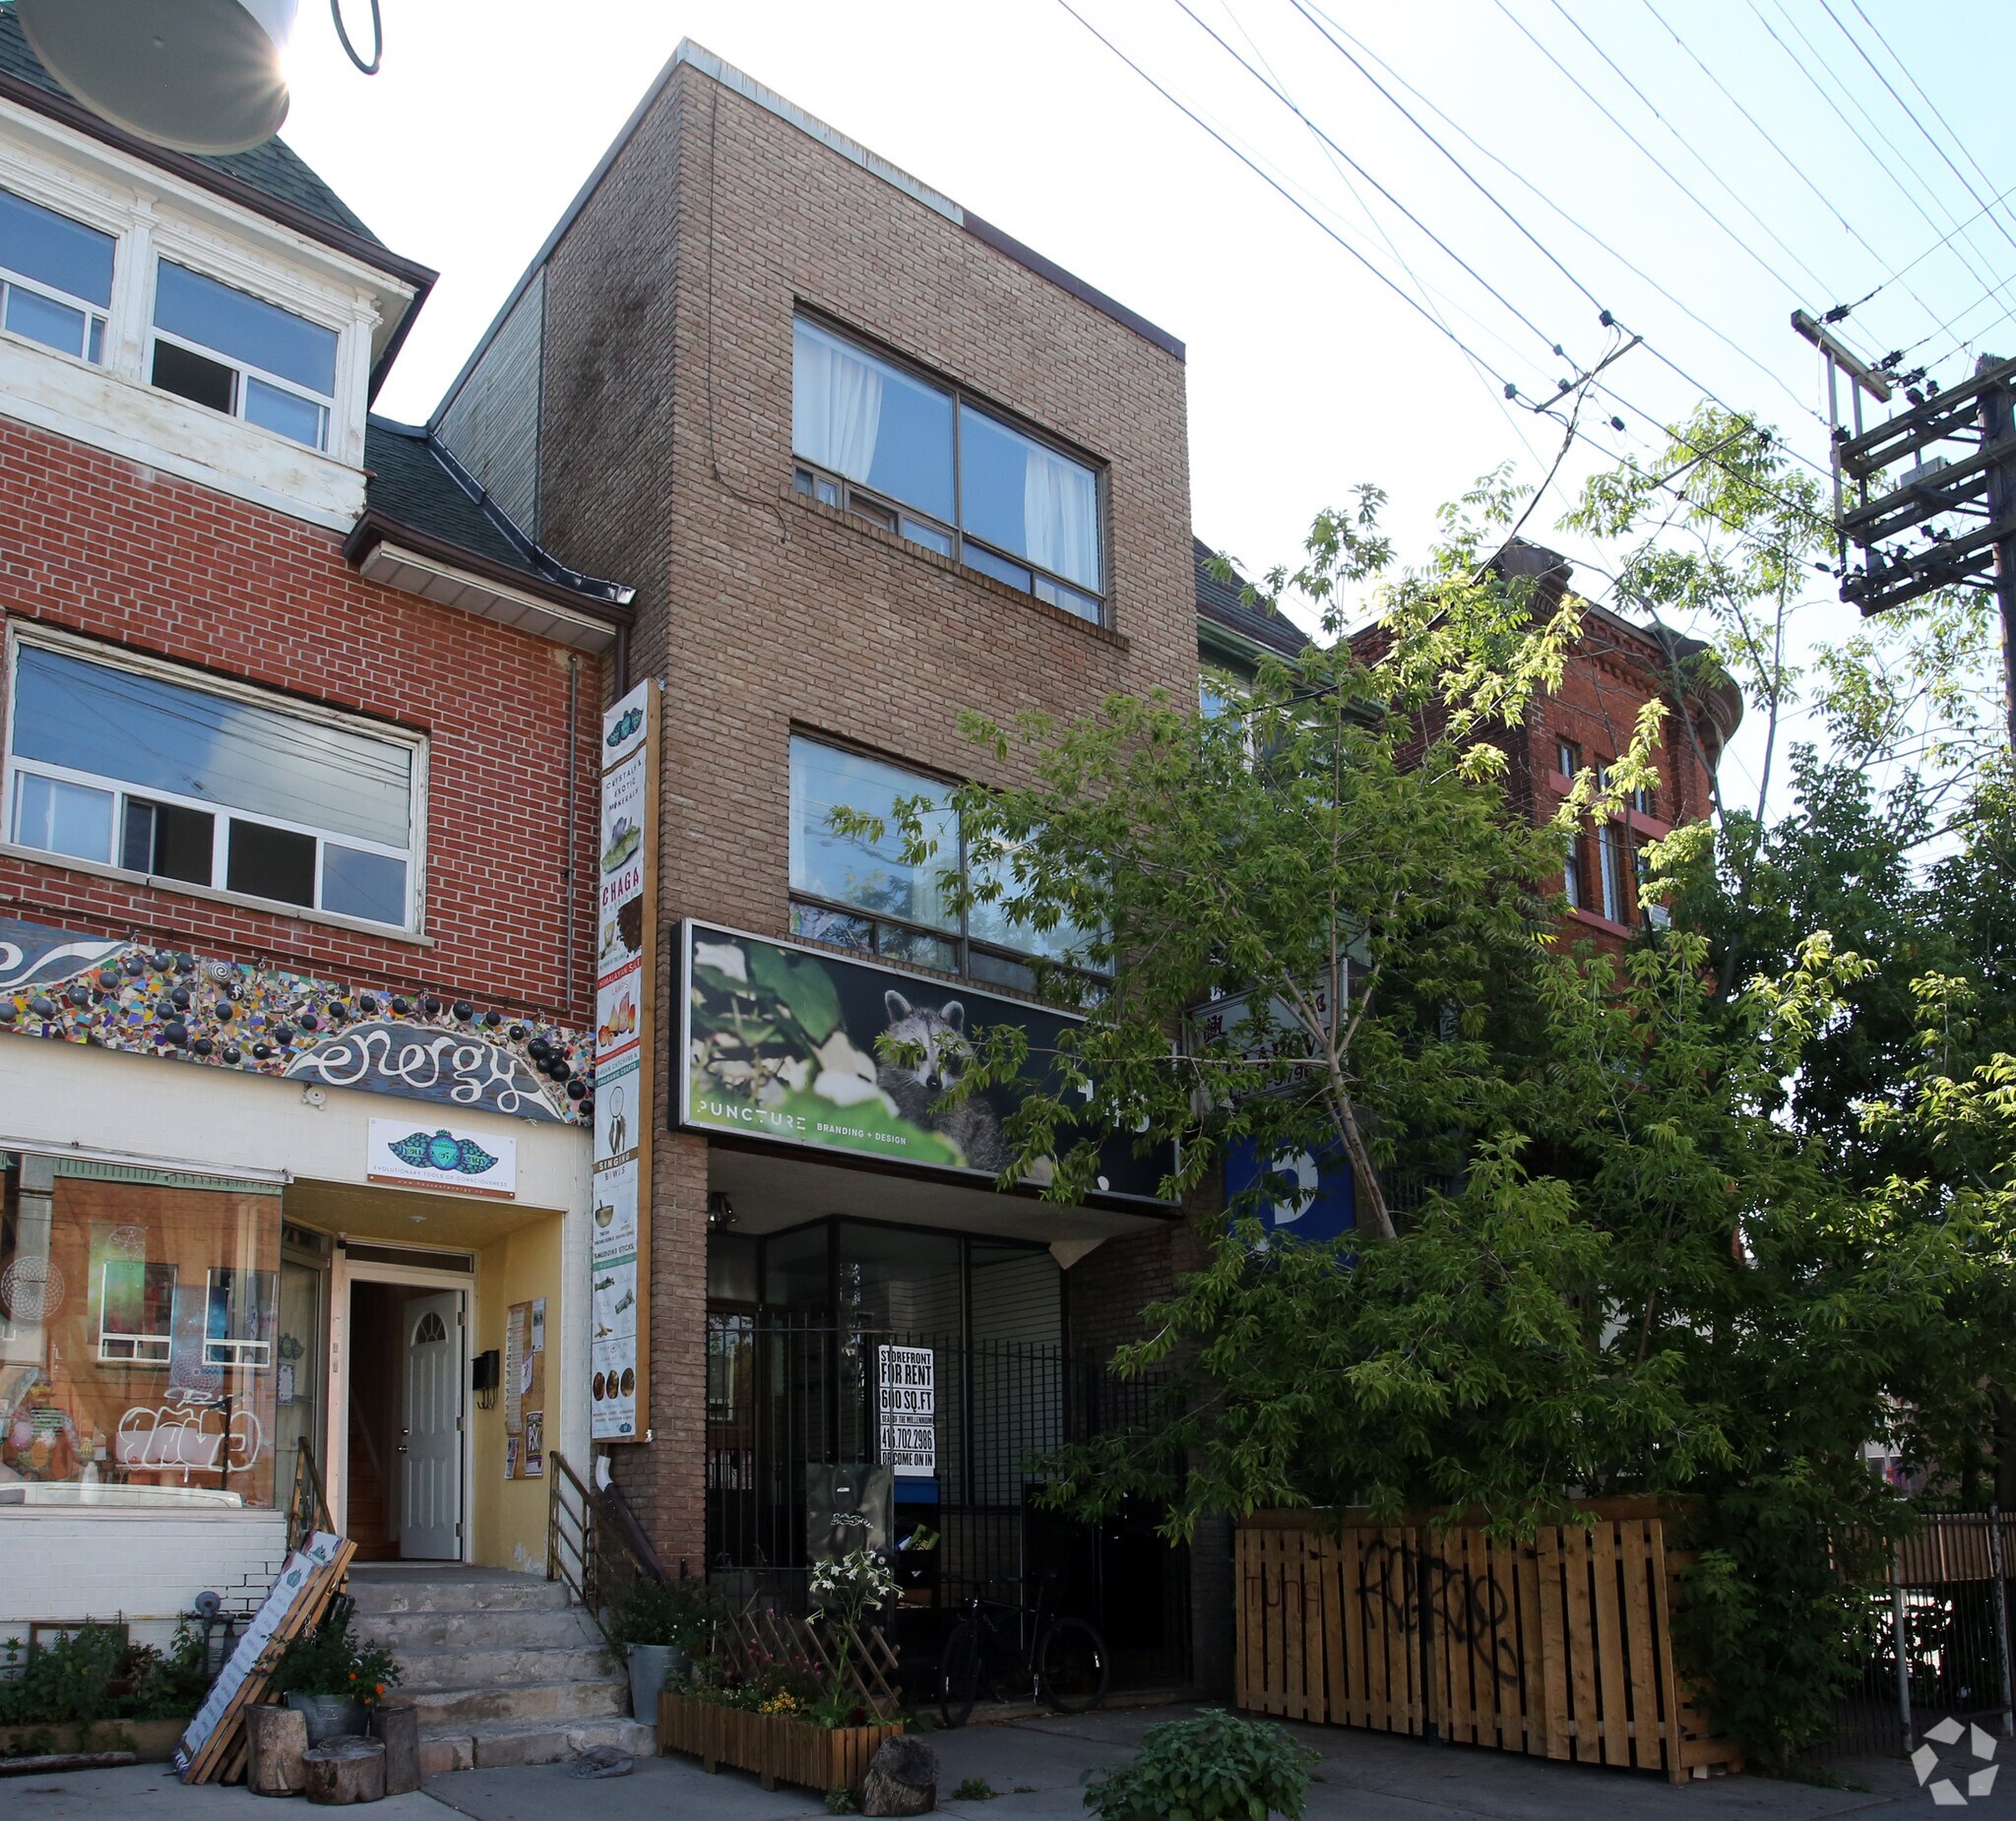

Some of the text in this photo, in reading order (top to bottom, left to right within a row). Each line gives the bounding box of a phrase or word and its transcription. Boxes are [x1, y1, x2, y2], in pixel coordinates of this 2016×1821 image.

[608, 786, 639, 811] MINERALS
[614, 777, 636, 797] EXOTIC
[602, 866, 639, 906] CHAGA
[286, 1030, 561, 1119] energy
[697, 1099, 806, 1130] PUNCTURE
[816, 1122, 864, 1138] BRANDING
[875, 1132, 907, 1146] DESIGN
[598, 1153, 630, 1170] SINGING
[373, 1164, 422, 1176] EVOLUTIONARY
[457, 1175, 508, 1188] CONSCIOUSNESS
[881, 1350, 931, 1365] STOREFRONT
[881, 1362, 932, 1386] FOR RENT
[881, 1389, 932, 1413] 600 SQ.FT
[882, 1427, 933, 1450] 416.702.2986
[893, 1452, 914, 1466] COME
[914, 1453, 923, 1467] ON
[924, 1453, 933, 1467] IN
